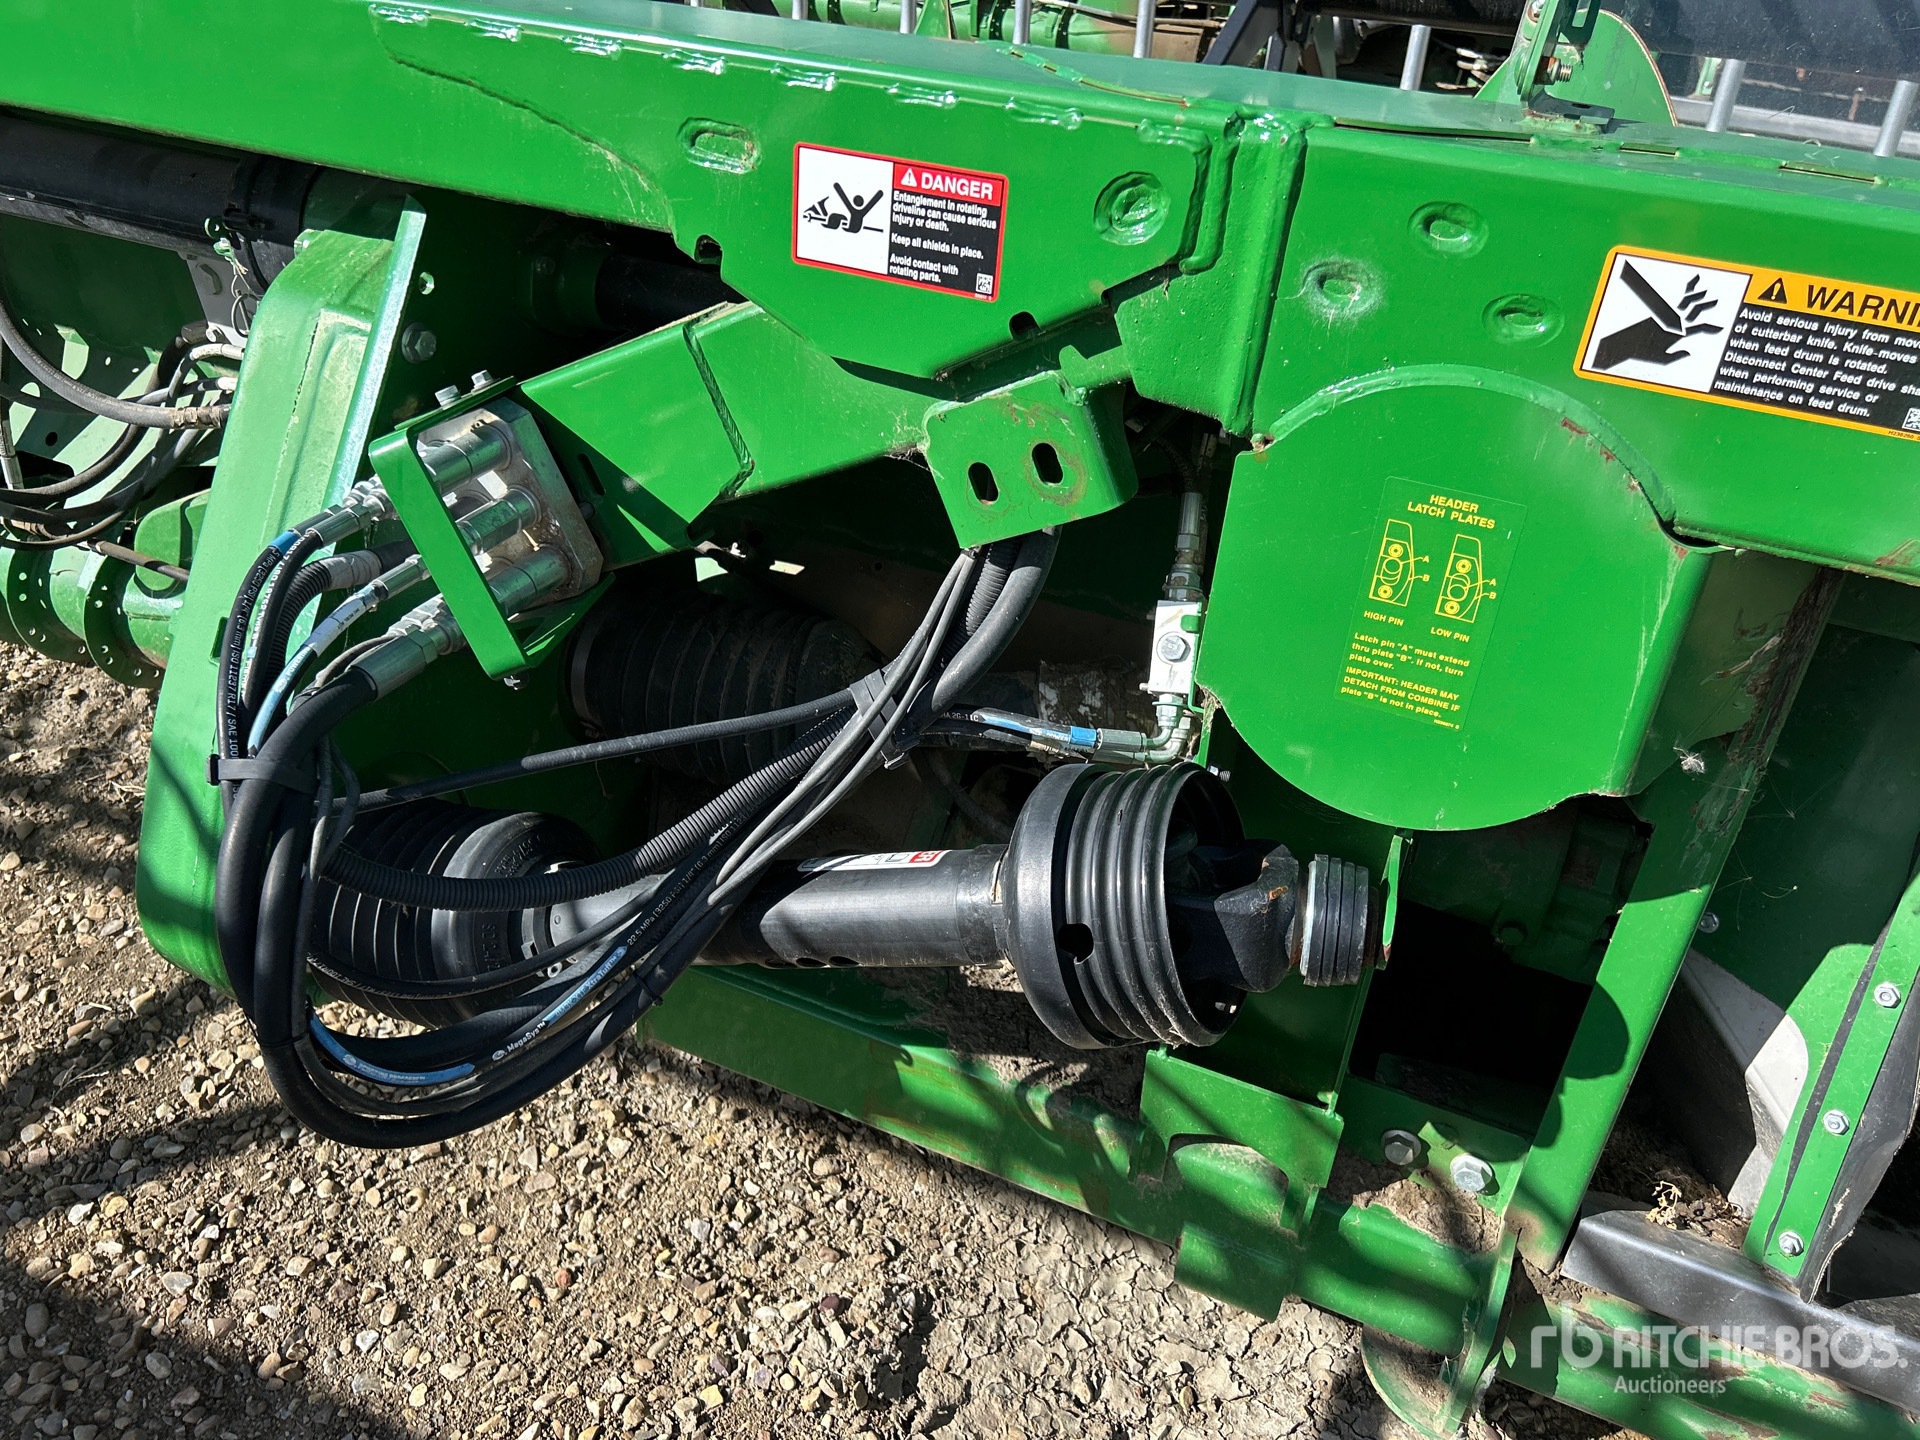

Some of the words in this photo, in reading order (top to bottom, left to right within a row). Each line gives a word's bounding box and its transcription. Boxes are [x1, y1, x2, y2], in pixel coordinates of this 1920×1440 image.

[921, 172, 993, 200] DANGER
[893, 202, 926, 216] driveline
[927, 210, 941, 219] can
[942, 212, 966, 224] cause
[967, 216, 996, 230] serious
[894, 190, 946, 209] Entanglement
[947, 200, 955, 211] in
[956, 204, 988, 218] rotating
[892, 212, 914, 227] injury
[916, 218, 924, 227] or
[925, 219, 949, 232] death.
[891, 233, 910, 247] Keep
[912, 238, 921, 247] all
[922, 239, 950, 253] shields
[952, 244, 959, 254] in
[960, 246, 984, 260] place.
[890, 253, 912, 266] Avoid
[912, 260, 940, 272] contact
[942, 264, 958, 275] with
[890, 265, 918, 280] rotating
[920, 271, 941, 283] parts.
[1807, 285, 1920, 327] WARNI
[1734, 323, 1748, 334] of
[1752, 326, 1802, 344] cutterbar
[1806, 335, 1837, 350] knife.
[1740, 308, 1772, 323] Avoid
[1776, 315, 1818, 331] serious
[1824, 322, 1857, 339] injury
[1862, 329, 1890, 344] from
[1730, 338, 1759, 352] when
[1764, 343, 1790, 356] feed
[1794, 348, 1824, 362] drum
[1828, 354, 1840, 366] is
[1844, 359, 1888, 374] rotated.
[1720, 366, 1749, 380] when
[1753, 372, 1814, 393] performing
[1819, 384, 1860, 400] service
[1865, 393, 1879, 403] or
[1724, 351, 1786, 372] Disconnect
[1791, 364, 1828, 378] Center
[1833, 370, 1862, 385] Feed
[1866, 378, 1896, 391] drive
[1714, 380, 1784, 401] maintenance
[1788, 394, 1804, 404] on
[1808, 396, 1834, 410] feed
[1838, 402, 1870, 418] drum.
[1408, 502, 1445, 518] LATCH
[1450, 511, 1496, 529] PLATES
[1430, 494, 1478, 514] HEADER
[1422, 574, 1430, 582] B
[1489, 578, 1496, 586] A
[1489, 592, 1496, 600] B
[1364, 610, 1386, 622] HIGH
[1388, 616, 1404, 626] PIN
[1430, 627, 1452, 638] LOW
[1454, 632, 1470, 642] PIN
[231, 647, 240, 666] ISO
[1349, 652, 1371, 664] plate
[1372, 659, 1394, 670] over.
[1352, 642, 1370, 652] thru
[1372, 648, 1394, 658] plate
[1416, 658, 1424, 666] If
[1424, 662, 1442, 672] not,
[1444, 666, 1464, 676] turn
[1354, 632, 1378, 644] Latch
[1380, 640, 1395, 648] pin
[1398, 643, 1413, 652] "A"
[1414, 647, 1436, 658] must
[1438, 654, 1470, 666] extend
[228, 665, 238, 694] 11237
[1346, 666, 1398, 686] IMPORTANT:
[1400, 680, 1438, 695] HEADER
[1440, 690, 1460, 701] MAY
[226, 694, 237, 710] R17
[1341, 686, 1362, 697] plate
[1390, 698, 1404, 708] not
[1406, 702, 1414, 710] in
[1416, 706, 1442, 718] place.
[1344, 676, 1378, 690] DETACH
[1380, 686, 1406, 698] FROM
[1408, 692, 1449, 710] COMBINE
[1450, 704, 1460, 712] IF
[228, 719, 238, 736] SAE
[229, 739, 240, 759] 100
[626, 930, 643, 946] 22.5
[640, 918, 655, 931] MPa
